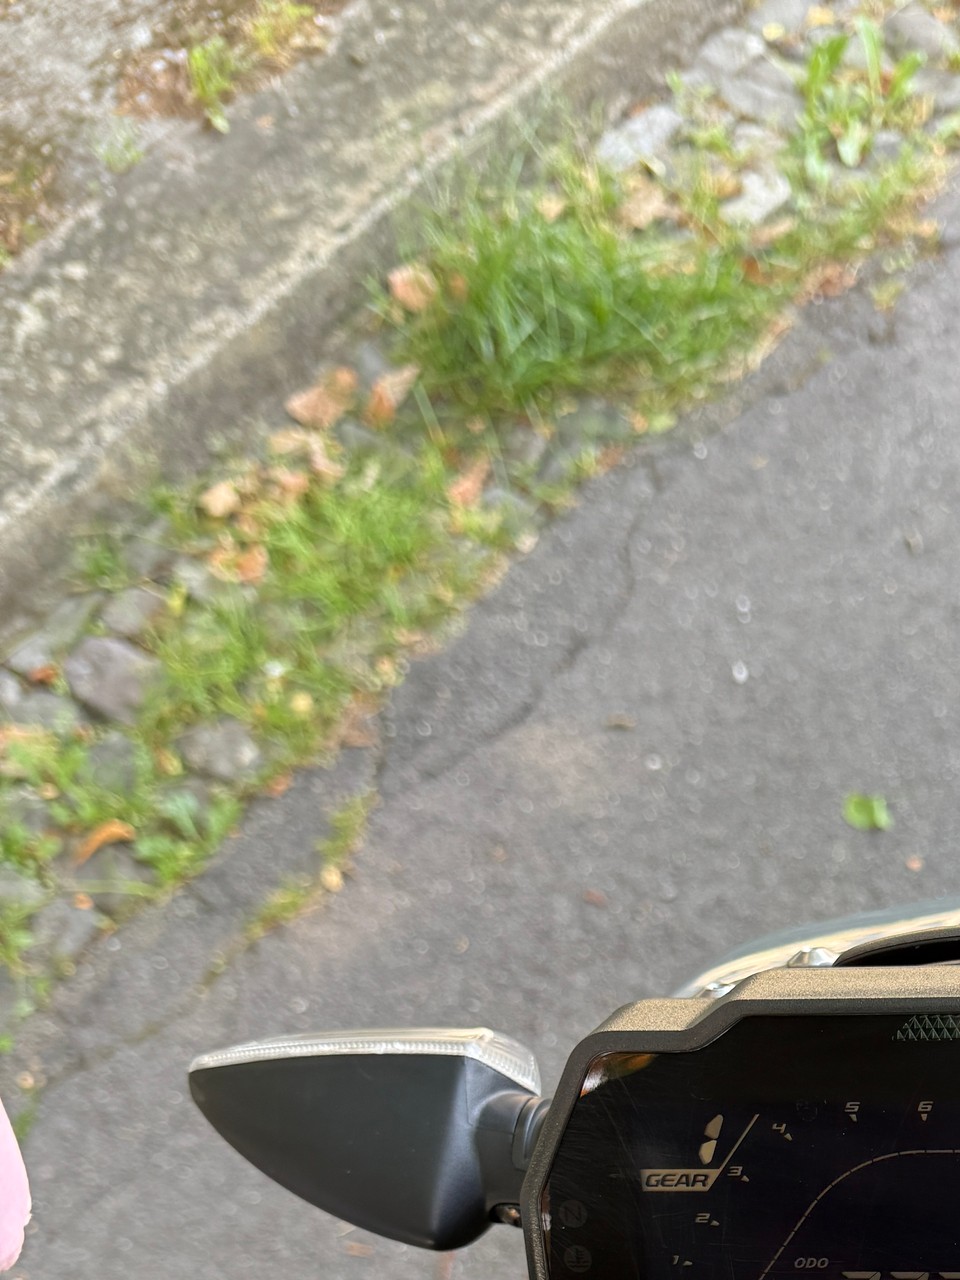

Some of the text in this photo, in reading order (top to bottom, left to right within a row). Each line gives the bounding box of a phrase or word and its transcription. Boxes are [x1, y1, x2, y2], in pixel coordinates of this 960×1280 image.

[844, 1101, 861, 1112] 5
[917, 1100, 934, 1112] 6
[772, 1123, 787, 1134] 4
[727, 1166, 744, 1177] 3
[645, 1173, 710, 1188] GEAR
[695, 1213, 711, 1223] 2
[673, 1255, 680, 1266] 1
[794, 1257, 830, 1269] ODO
